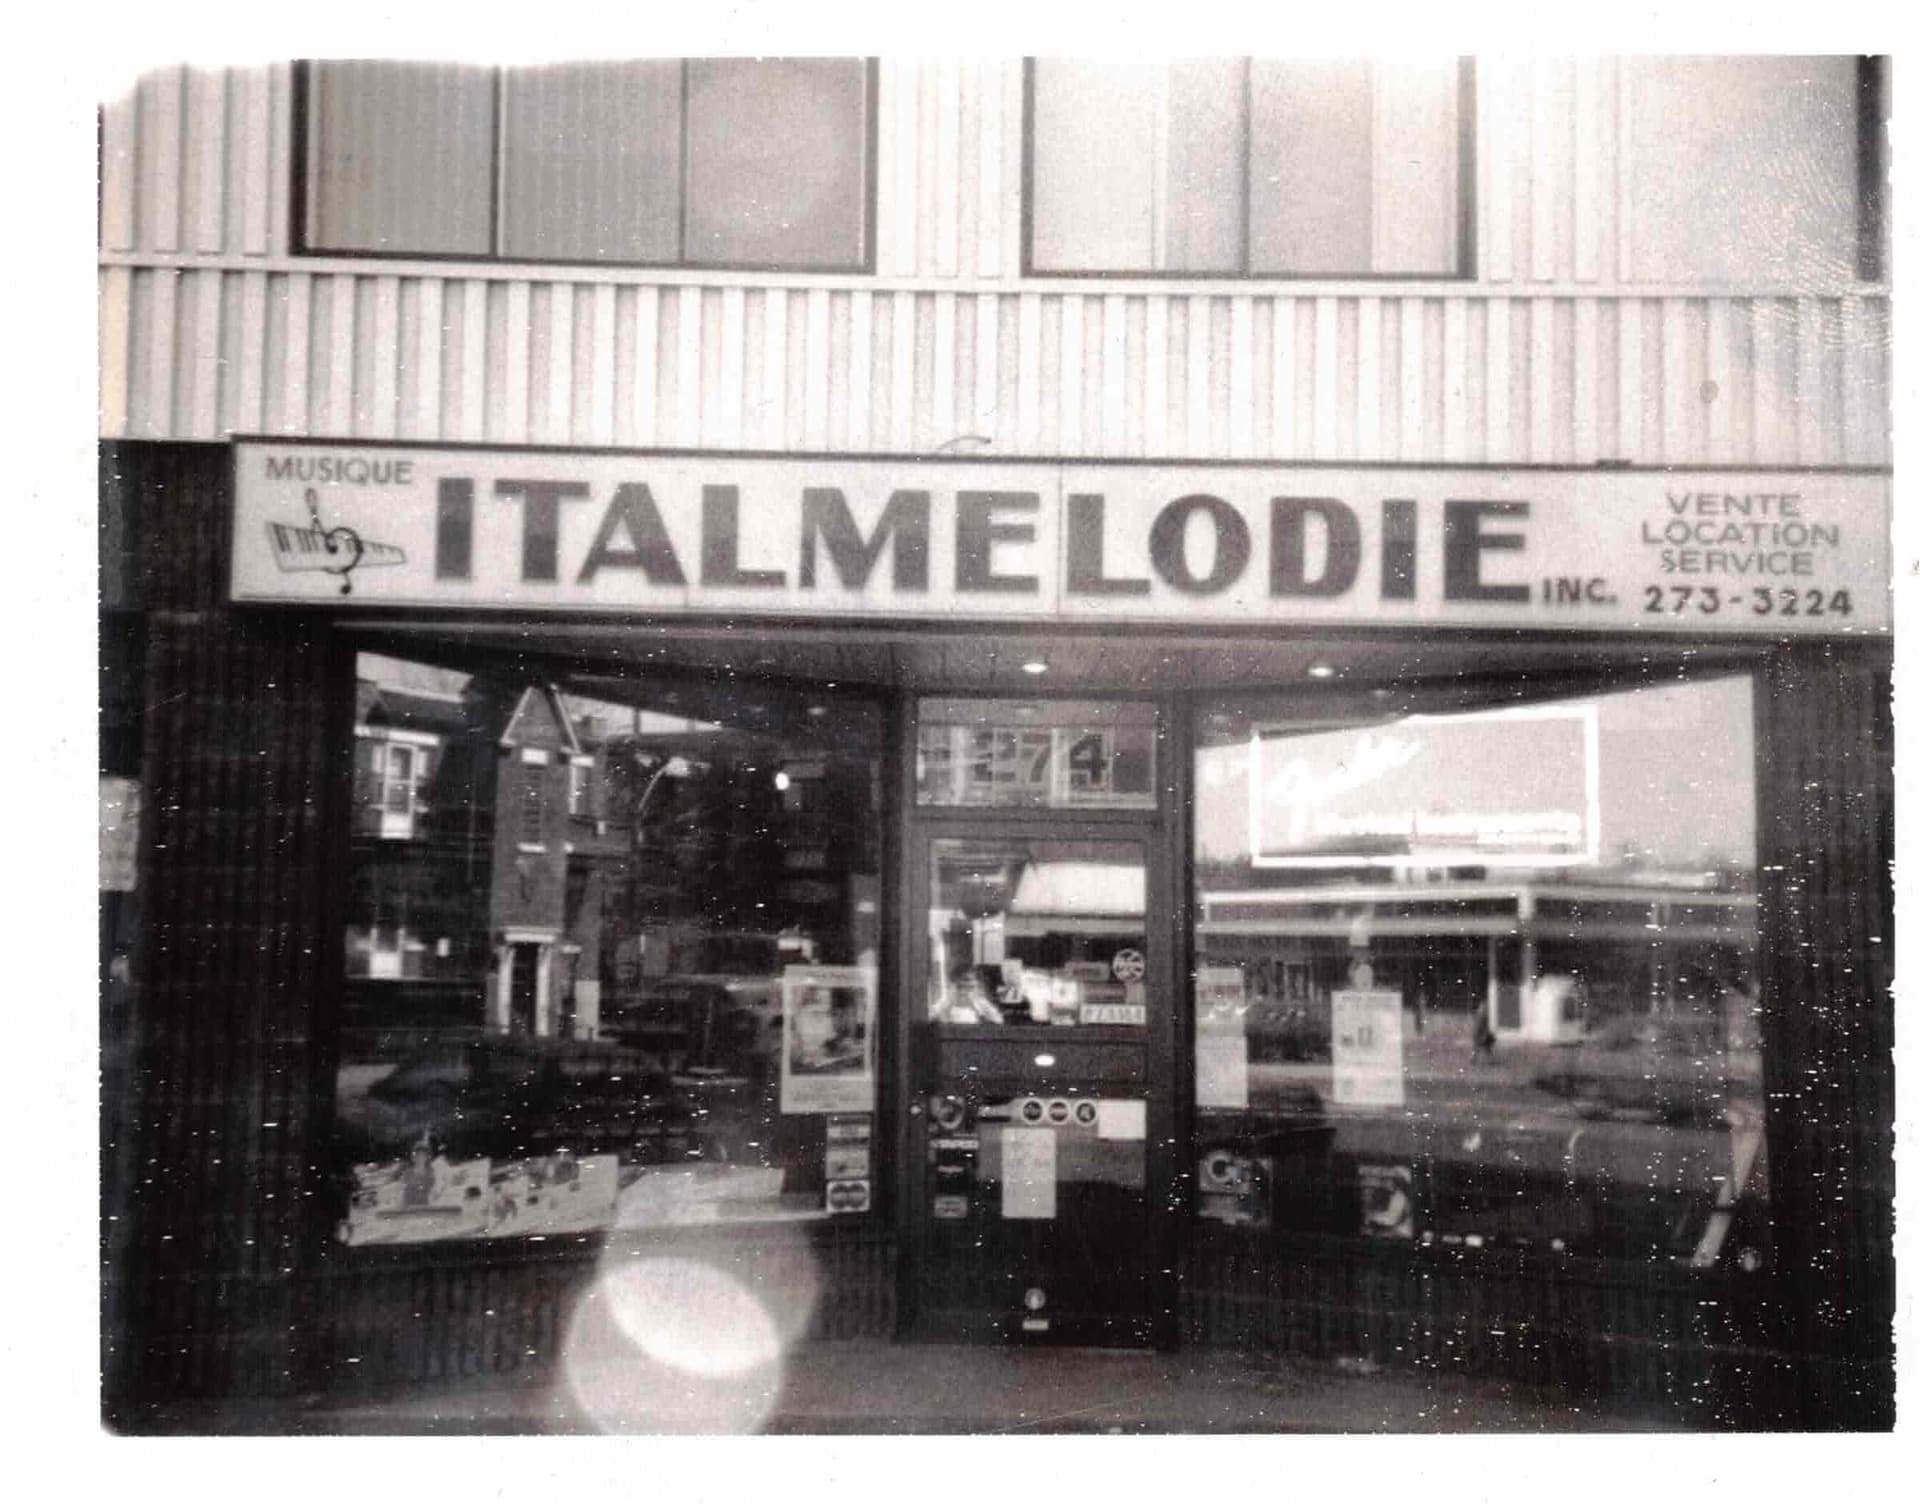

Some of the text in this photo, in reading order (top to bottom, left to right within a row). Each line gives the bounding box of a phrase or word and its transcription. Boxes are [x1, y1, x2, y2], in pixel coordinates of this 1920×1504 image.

[266, 457, 413, 484] MUSIQUE
[1666, 492, 1802, 517] VENTE
[435, 477, 1618, 606] ITALMELODIE INC.
[1642, 521, 1840, 547] LOCATION
[1660, 550, 1813, 575] SERVICE
